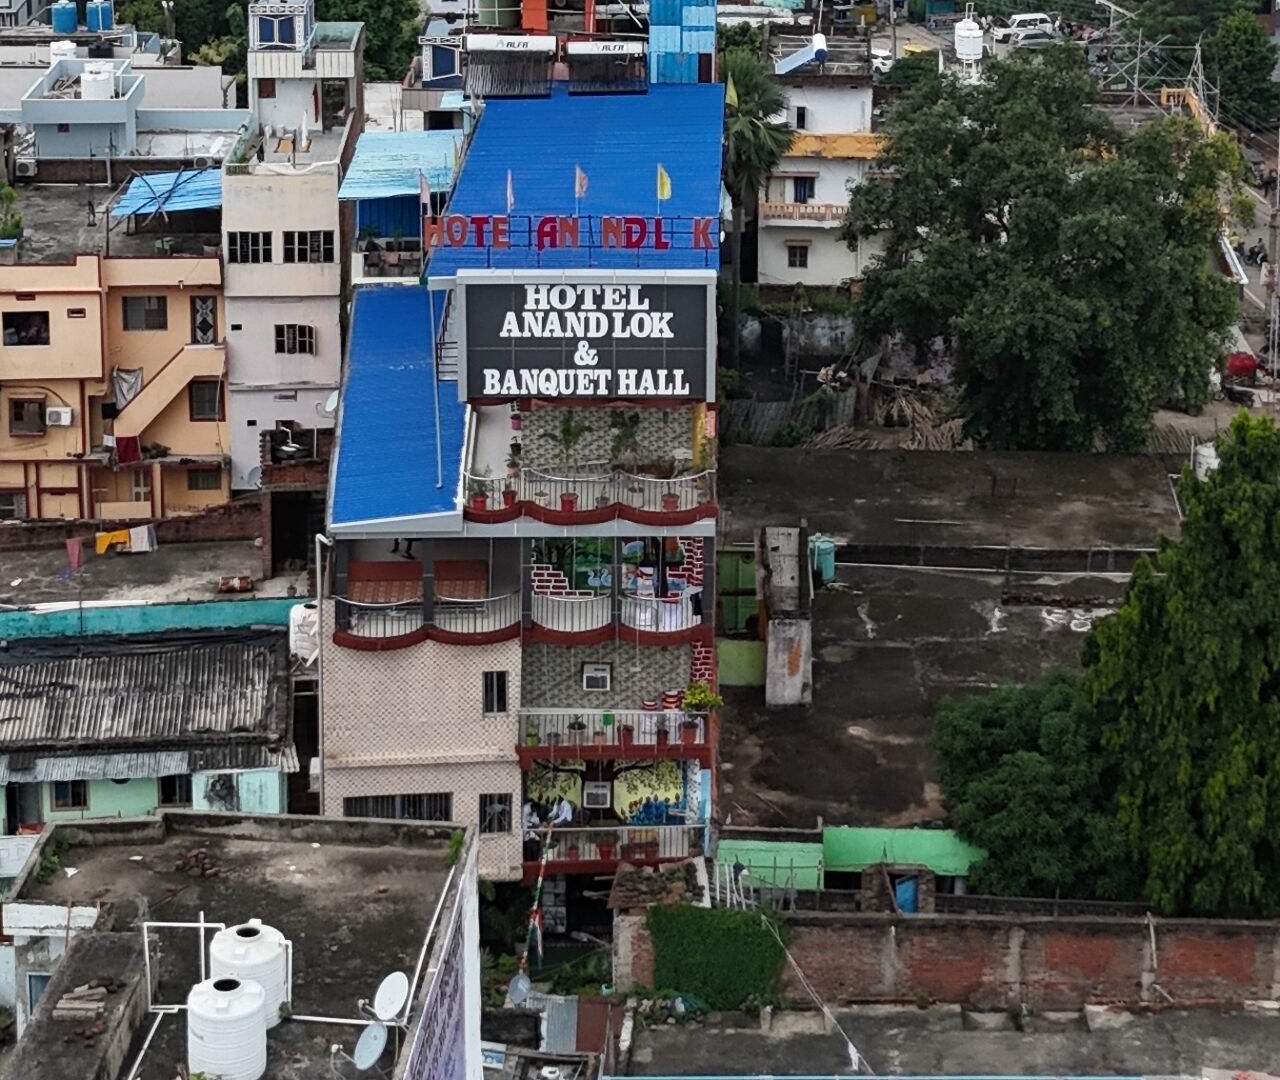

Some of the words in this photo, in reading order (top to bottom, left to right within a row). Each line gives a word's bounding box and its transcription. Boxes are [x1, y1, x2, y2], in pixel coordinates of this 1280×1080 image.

[506, 41, 529, 49] ALFA
[601, 44, 625, 52] ALFA
[523, 284, 650, 311] HOTEL
[573, 340, 599, 366] &
[483, 368, 612, 397] BANQUET
[617, 368, 690, 396] HALL
